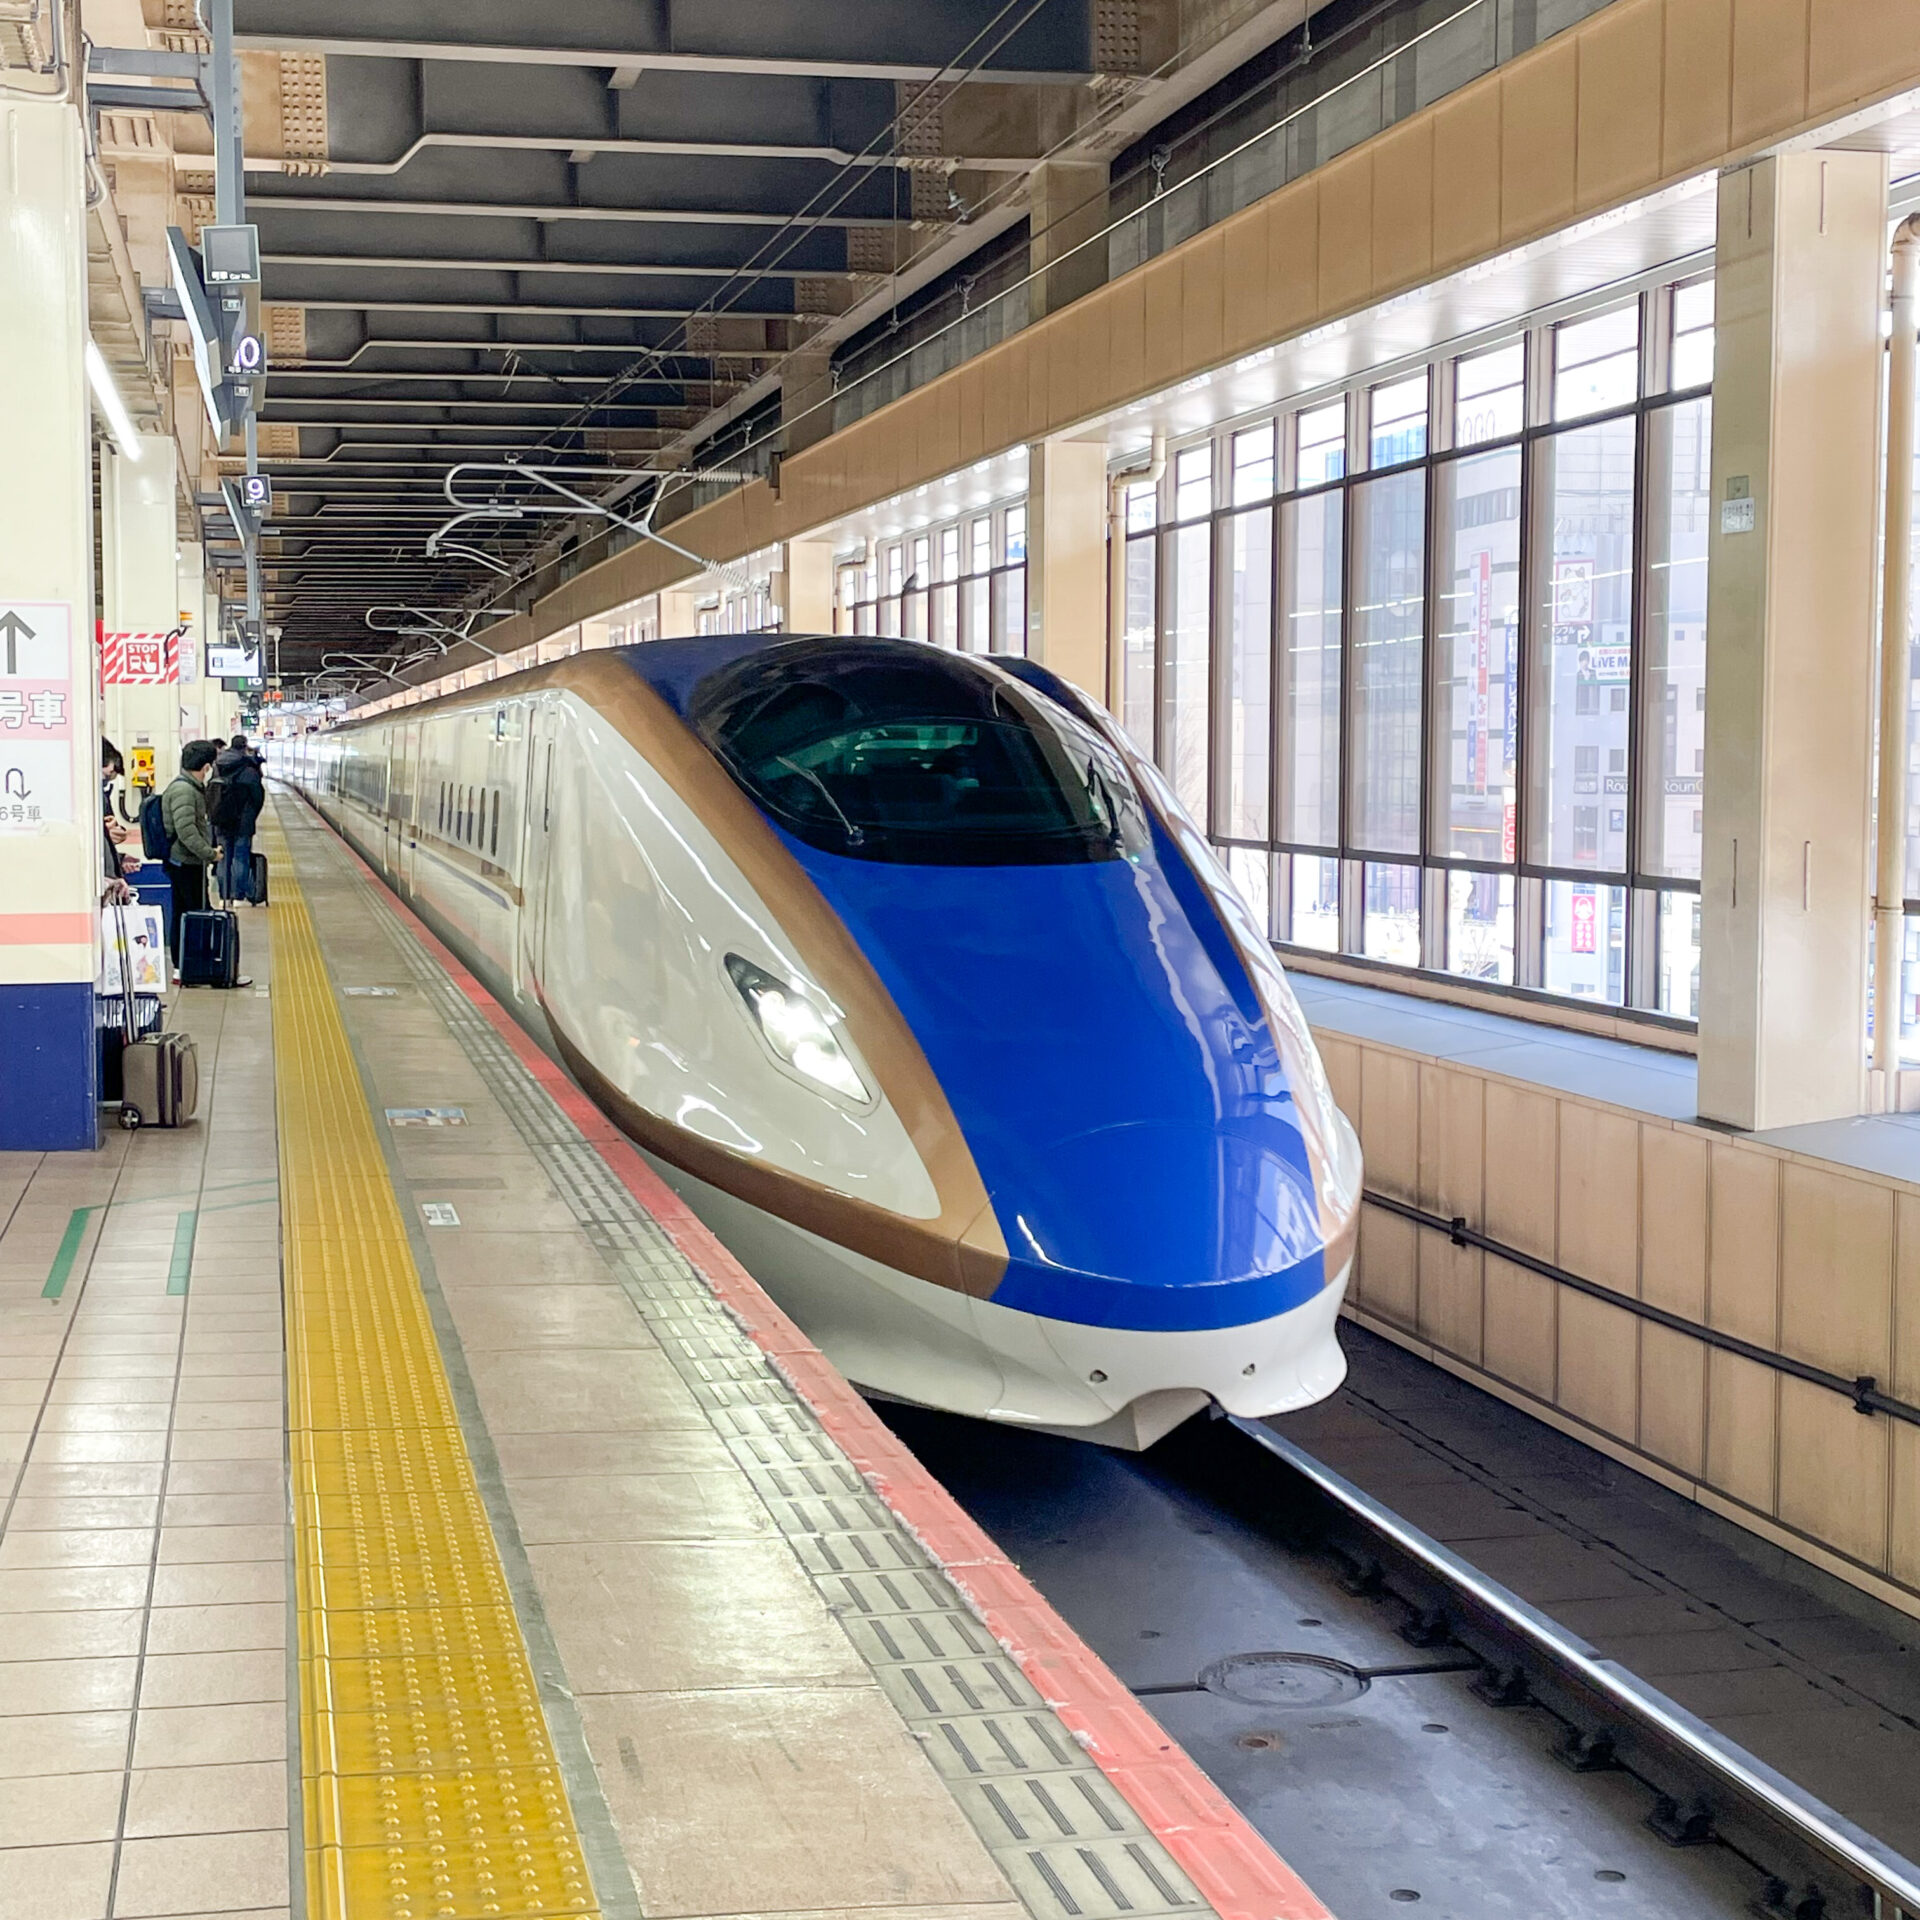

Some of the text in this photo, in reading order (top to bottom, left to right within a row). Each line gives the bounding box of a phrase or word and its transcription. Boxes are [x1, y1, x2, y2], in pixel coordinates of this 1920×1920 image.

[247, 478, 264, 500] 9
[127, 644, 157, 653] STOP
[1606, 779, 1629, 792] Rou
